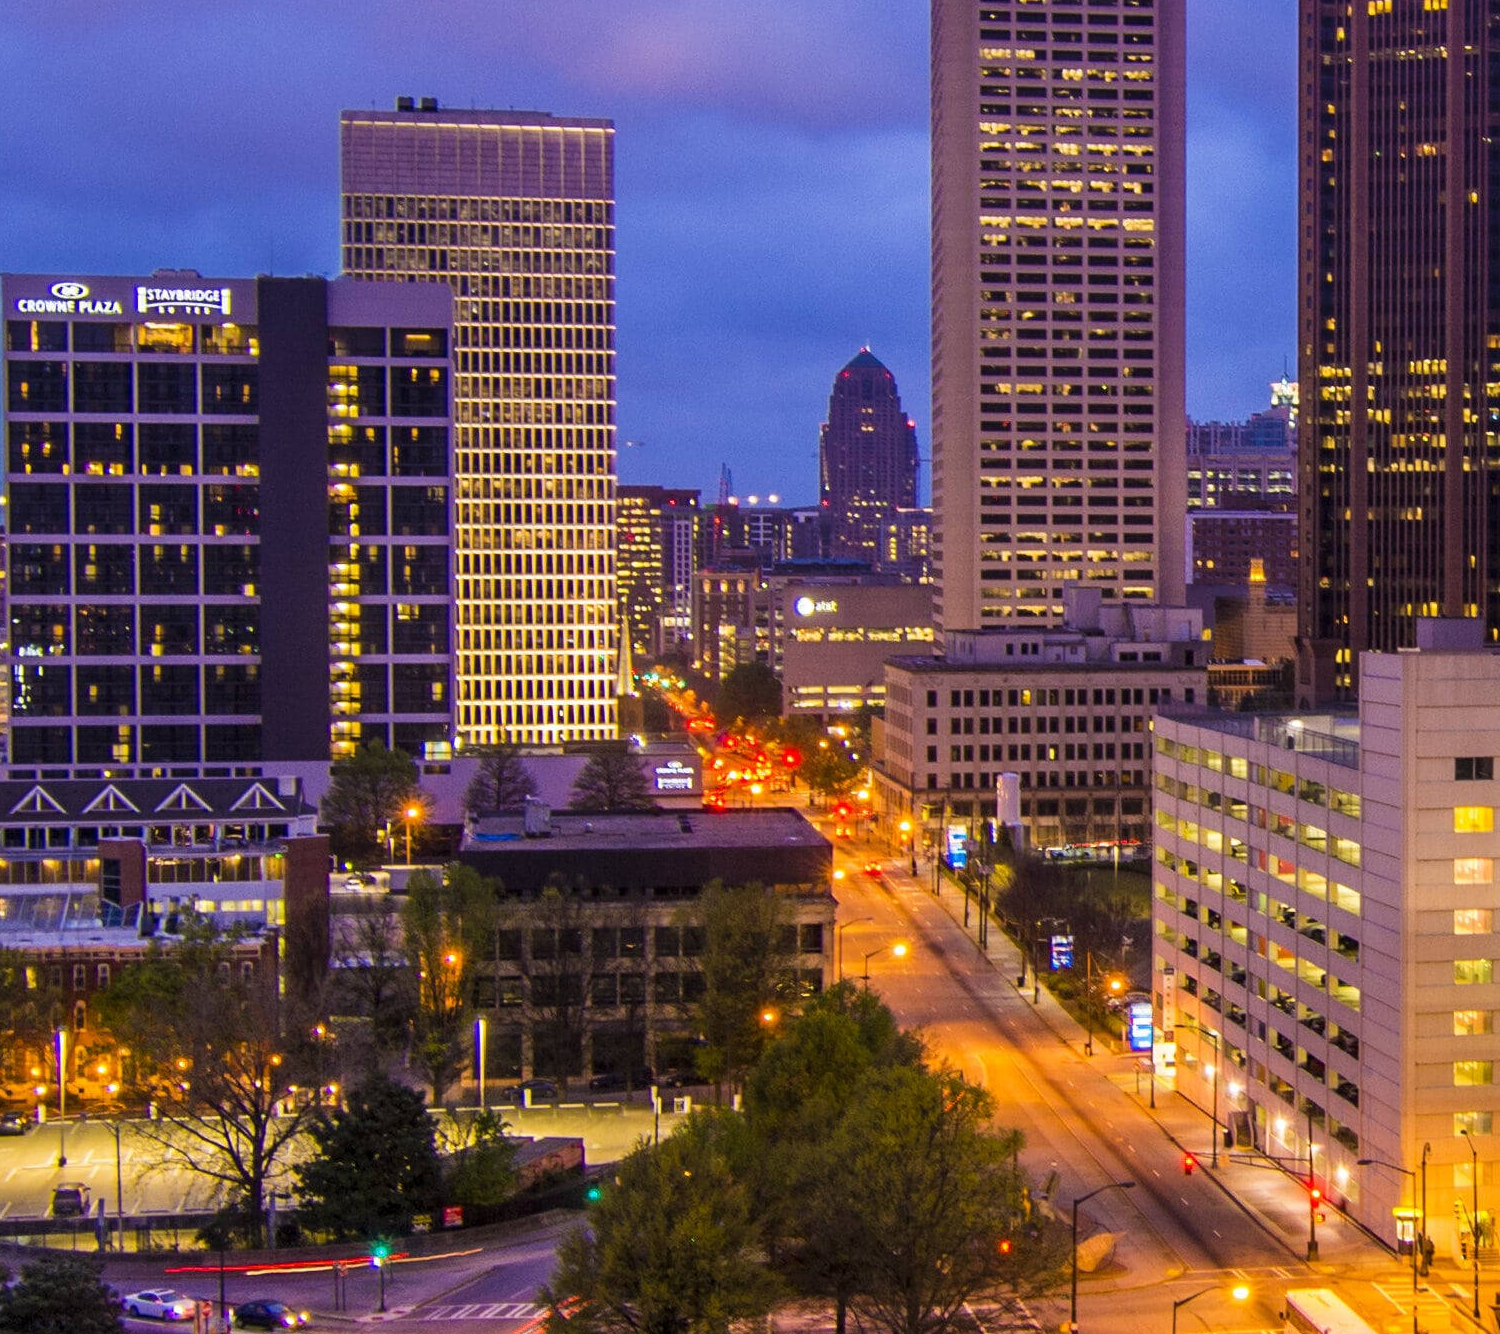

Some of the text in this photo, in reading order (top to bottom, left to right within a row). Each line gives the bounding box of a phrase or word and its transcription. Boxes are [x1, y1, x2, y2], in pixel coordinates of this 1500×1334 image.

[147, 288, 221, 302] STAYBRIDGE
[18, 298, 123, 314] CROWNE PLAZA
